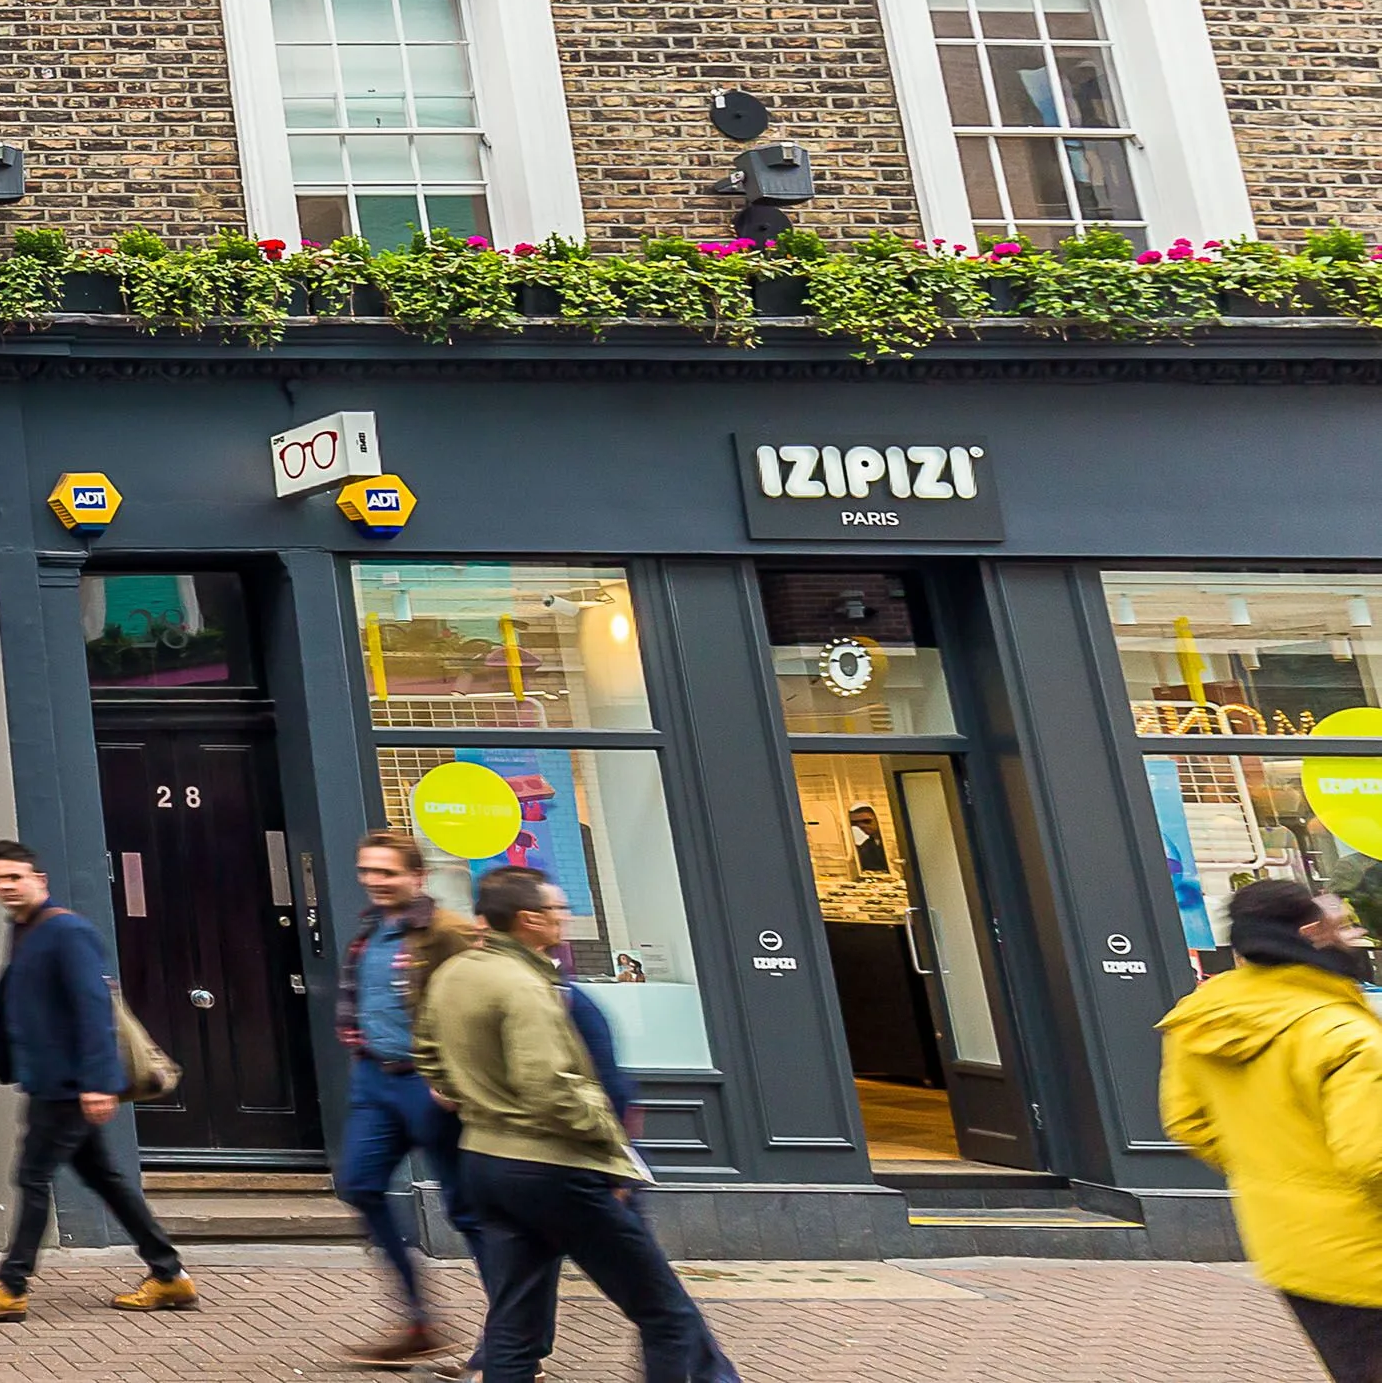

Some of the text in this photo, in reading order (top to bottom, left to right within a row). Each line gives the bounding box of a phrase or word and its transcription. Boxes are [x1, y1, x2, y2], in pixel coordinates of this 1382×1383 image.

[756, 445, 978, 499] IZIPIZI
[75, 492, 105, 505] ADT
[367, 493, 399, 508] ADT
[841, 512, 900, 525] PARIS
